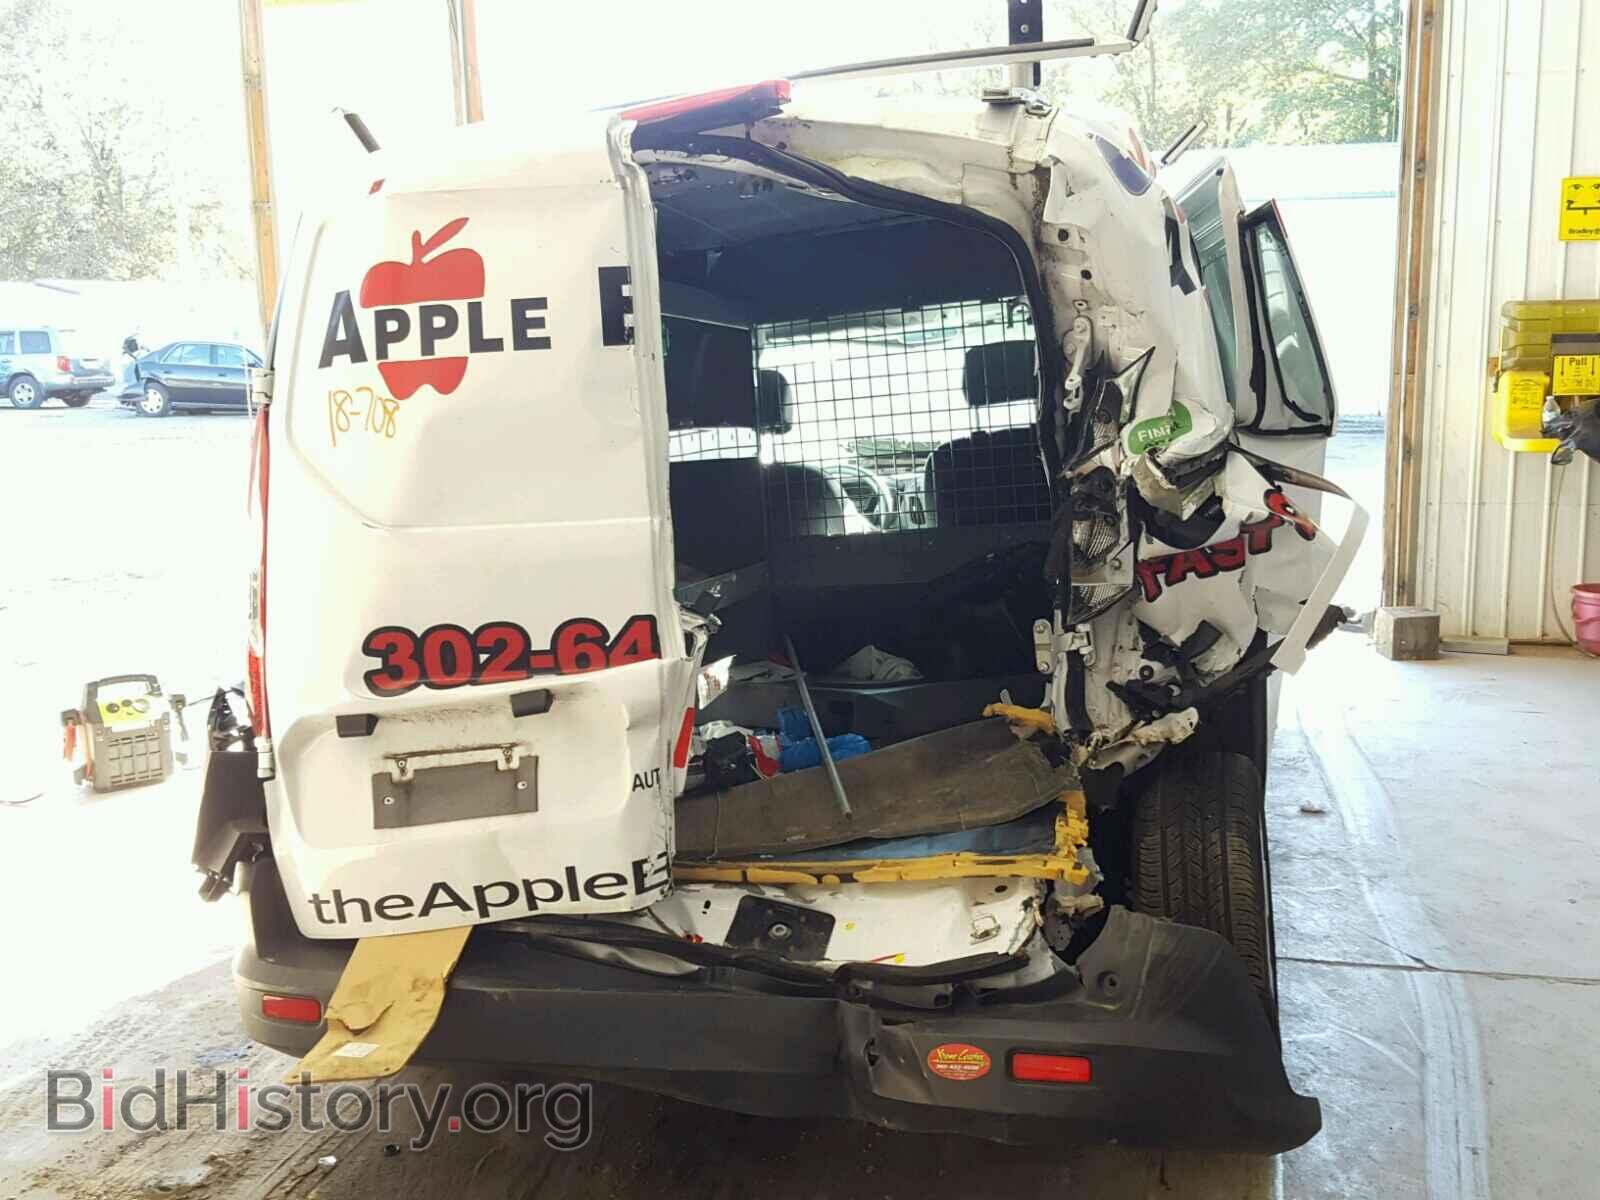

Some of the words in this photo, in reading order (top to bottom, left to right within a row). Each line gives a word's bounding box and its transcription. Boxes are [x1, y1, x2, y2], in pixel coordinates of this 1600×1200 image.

[317, 289, 552, 369] APPLE
[1568, 357, 1587, 366] Pull
[328, 386, 400, 448] 18-708
[362, 614, 661, 697] 302-64
